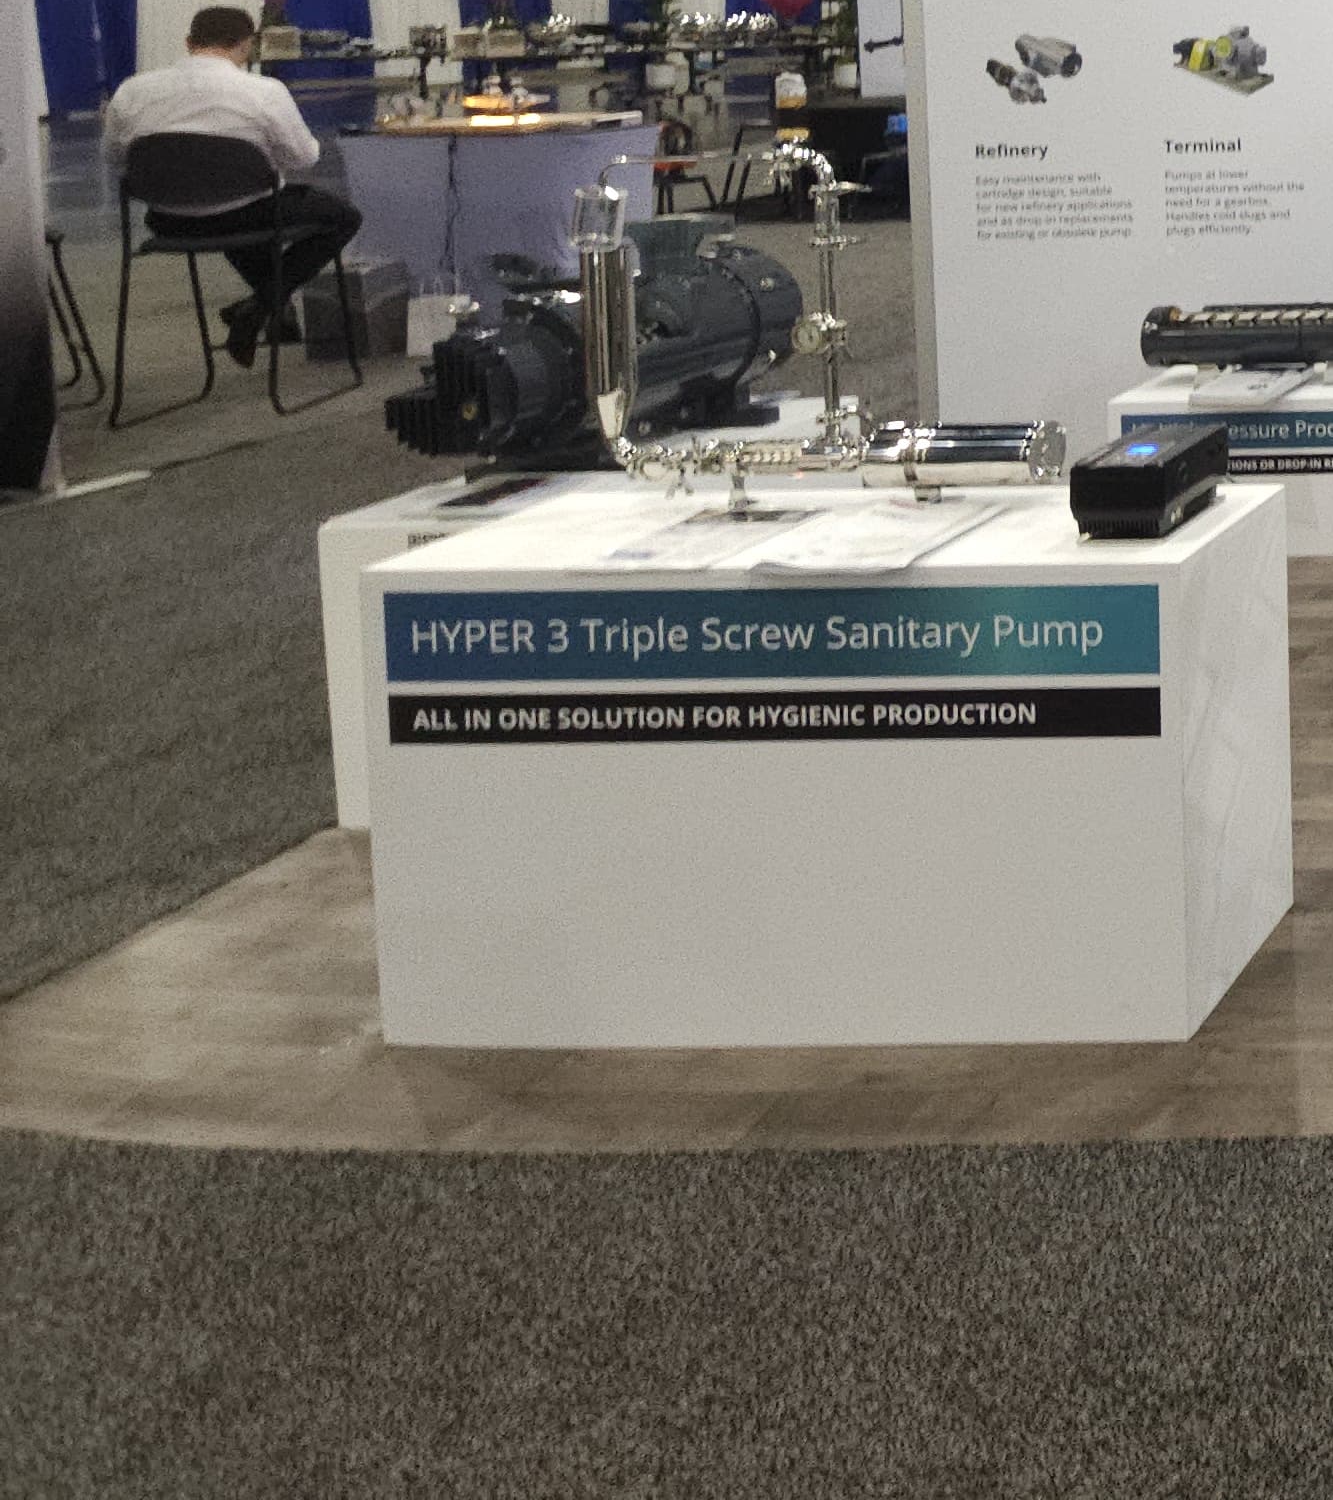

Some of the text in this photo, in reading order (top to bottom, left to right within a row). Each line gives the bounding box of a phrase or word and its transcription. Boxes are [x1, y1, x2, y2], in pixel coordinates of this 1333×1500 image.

[974, 143, 1048, 161] Refinery
[1163, 137, 1242, 154] Terminal
[1259, 458, 1275, 470] OR
[410, 614, 1104, 662] HYPER 3 Triple Screw Sanitary Pump
[412, 701, 1038, 733] ALL IN ONE SOLUTION FOR HYGIENIC PRODUCTION
